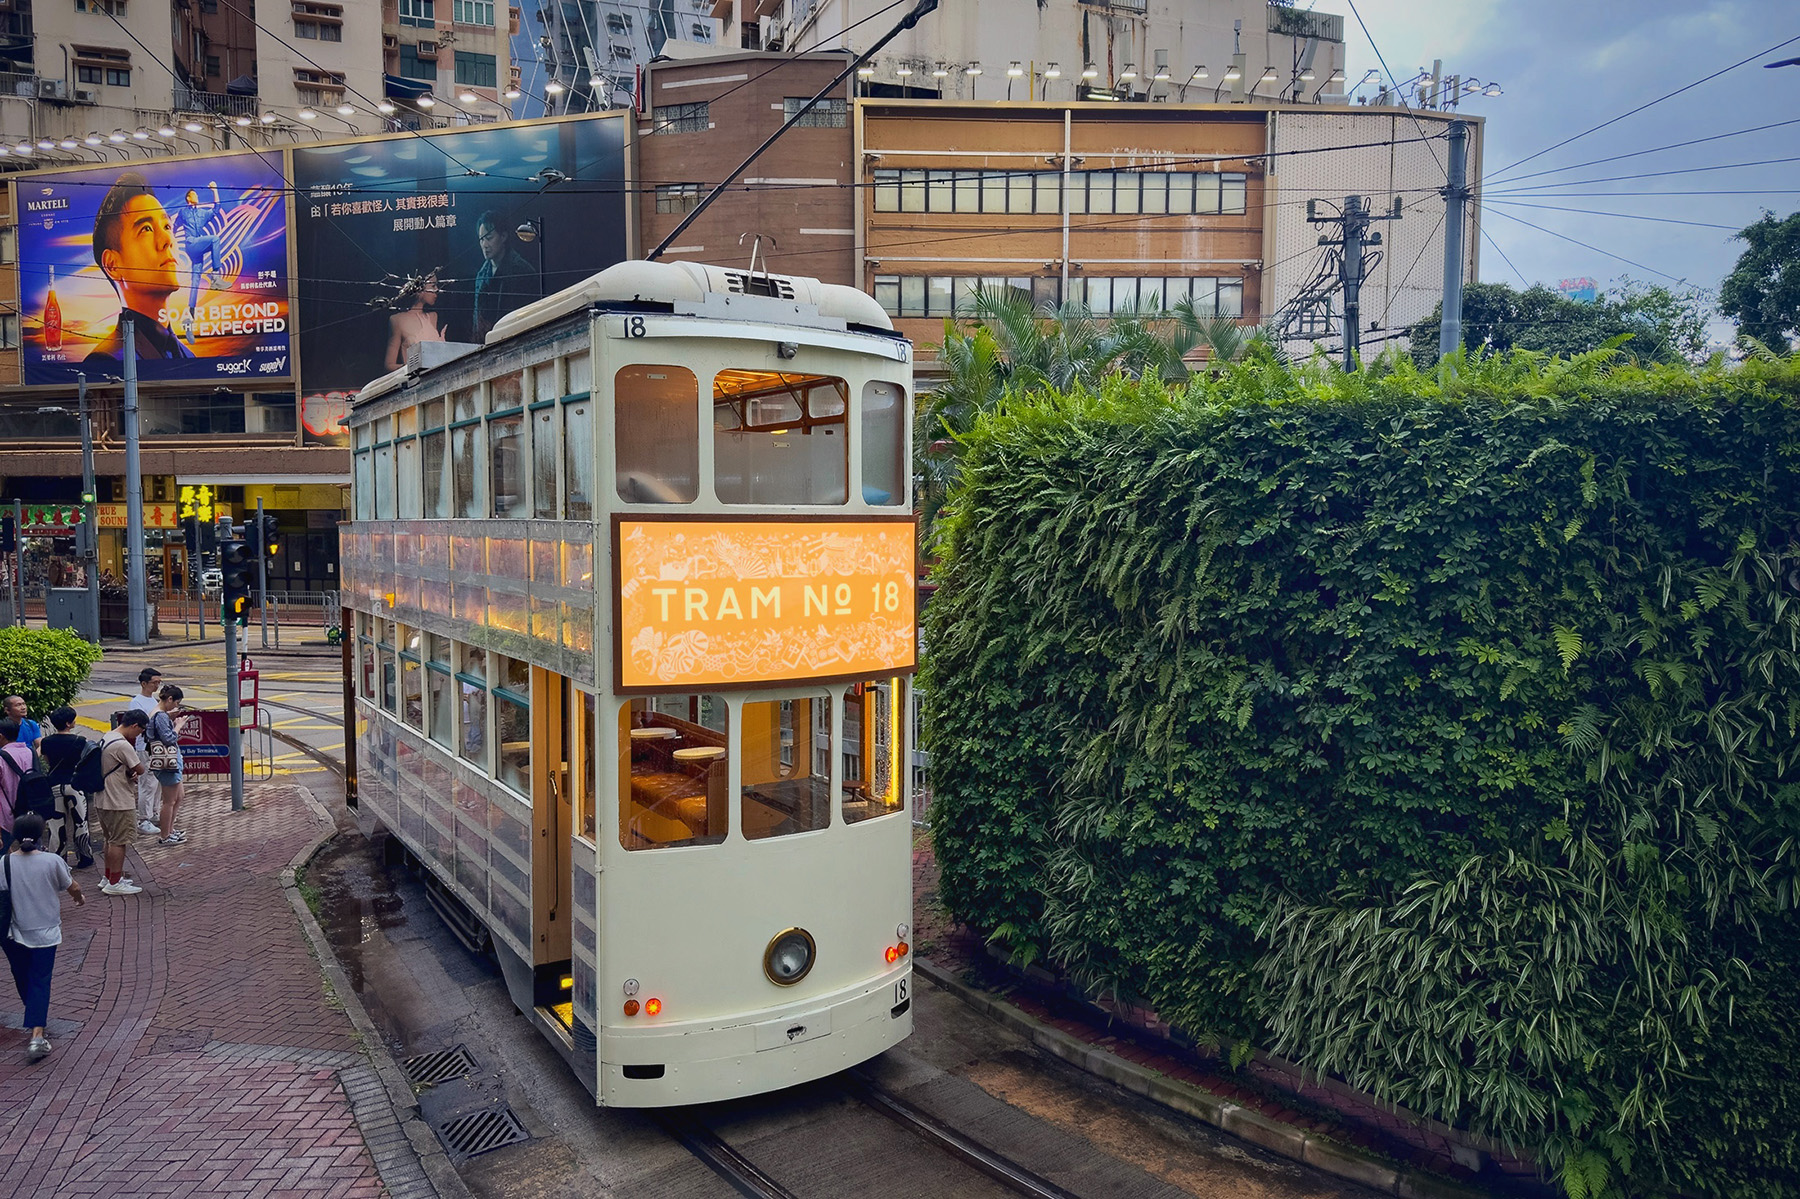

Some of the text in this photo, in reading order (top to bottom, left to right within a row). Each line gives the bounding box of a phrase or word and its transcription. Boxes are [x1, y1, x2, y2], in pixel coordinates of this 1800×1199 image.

[27, 199, 69, 212] MARTELL
[393, 214, 457, 232] 展開動人篇章
[158, 302, 279, 322] SOAR BEYOND
[200, 318, 286, 337] EXPECTED
[623, 315, 647, 338] 18
[895, 341, 907, 362] 18
[652, 586, 781, 622] TRAM
[871, 581, 899, 613] 18
[183, 761, 210, 769] ARTURE
[894, 978, 907, 1004] 18
